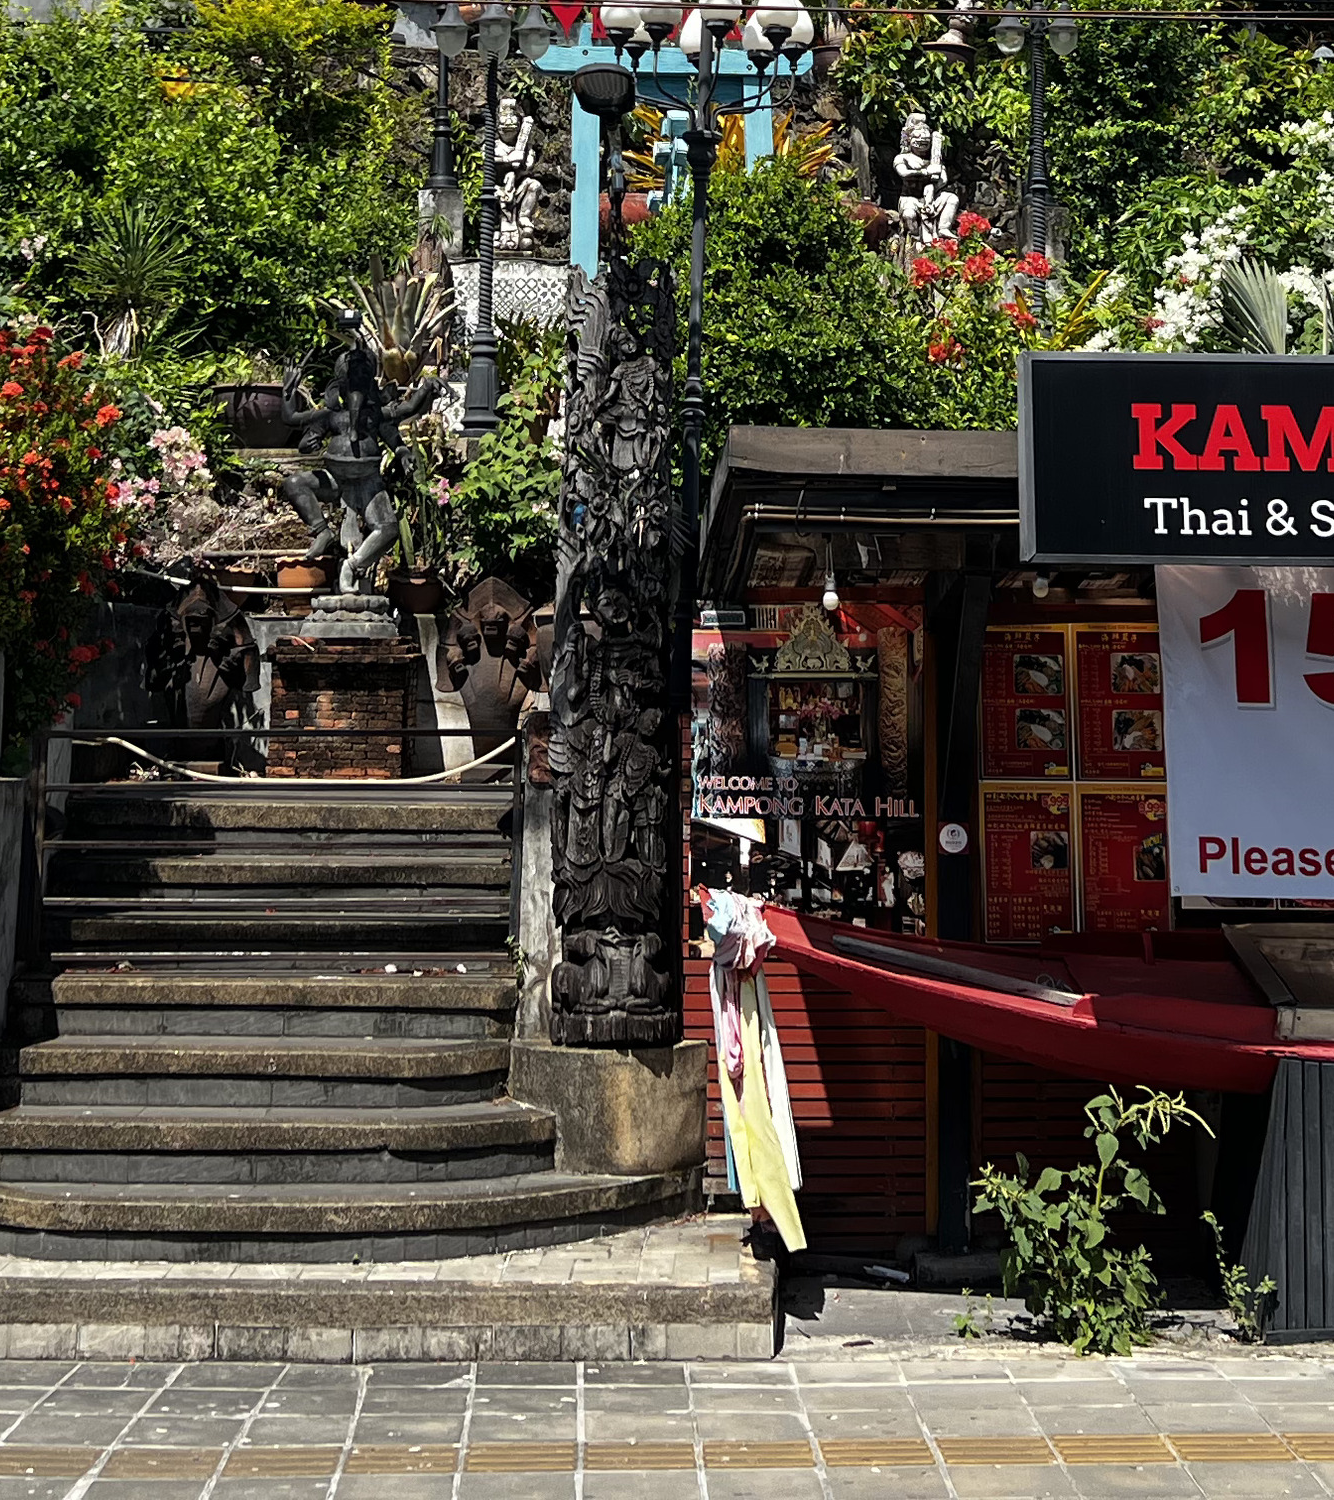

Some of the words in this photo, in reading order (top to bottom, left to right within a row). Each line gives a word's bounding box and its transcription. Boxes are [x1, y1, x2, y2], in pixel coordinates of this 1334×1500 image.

[1143, 497, 1253, 536] Thai
[1265, 498, 1299, 537] &
[697, 775, 774, 791] WELCOME
[777, 776, 799, 792] TO
[698, 794, 804, 816] KAMPONG
[814, 794, 866, 817] KATA
[875, 796, 920, 818] HILL
